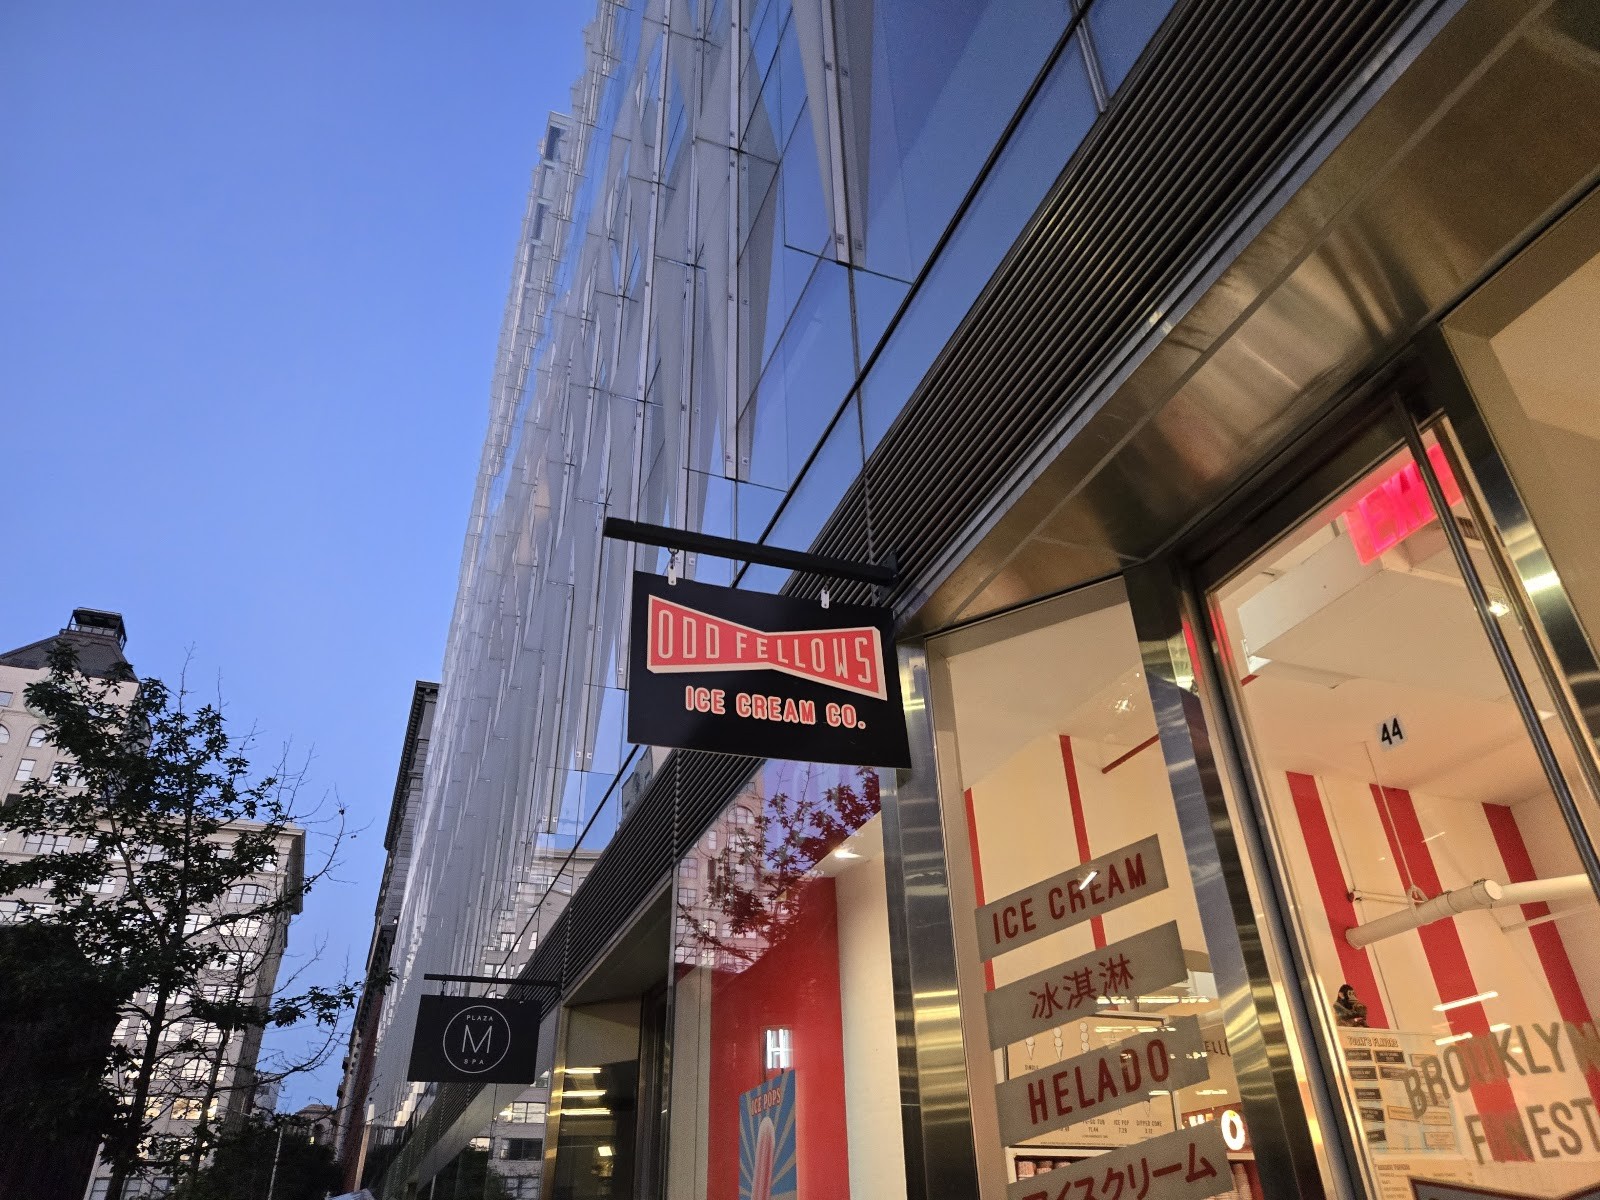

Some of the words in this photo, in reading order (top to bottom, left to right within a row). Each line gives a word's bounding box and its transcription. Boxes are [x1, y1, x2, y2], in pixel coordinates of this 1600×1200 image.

[658, 609, 720, 659] ODD
[736, 632, 871, 684] FELLOWS
[685, 685, 726, 715] ICE
[736, 692, 816, 726] CREAM
[826, 702, 867, 730] CO.
[1380, 717, 1404, 746] 44
[992, 897, 1037, 944] ICE
[1048, 852, 1147, 920] CREAM
[1029, 953, 1134, 1020] 冰淇淋
[462, 1024, 493, 1054] M
[1027, 1038, 1170, 1125] HELADO
